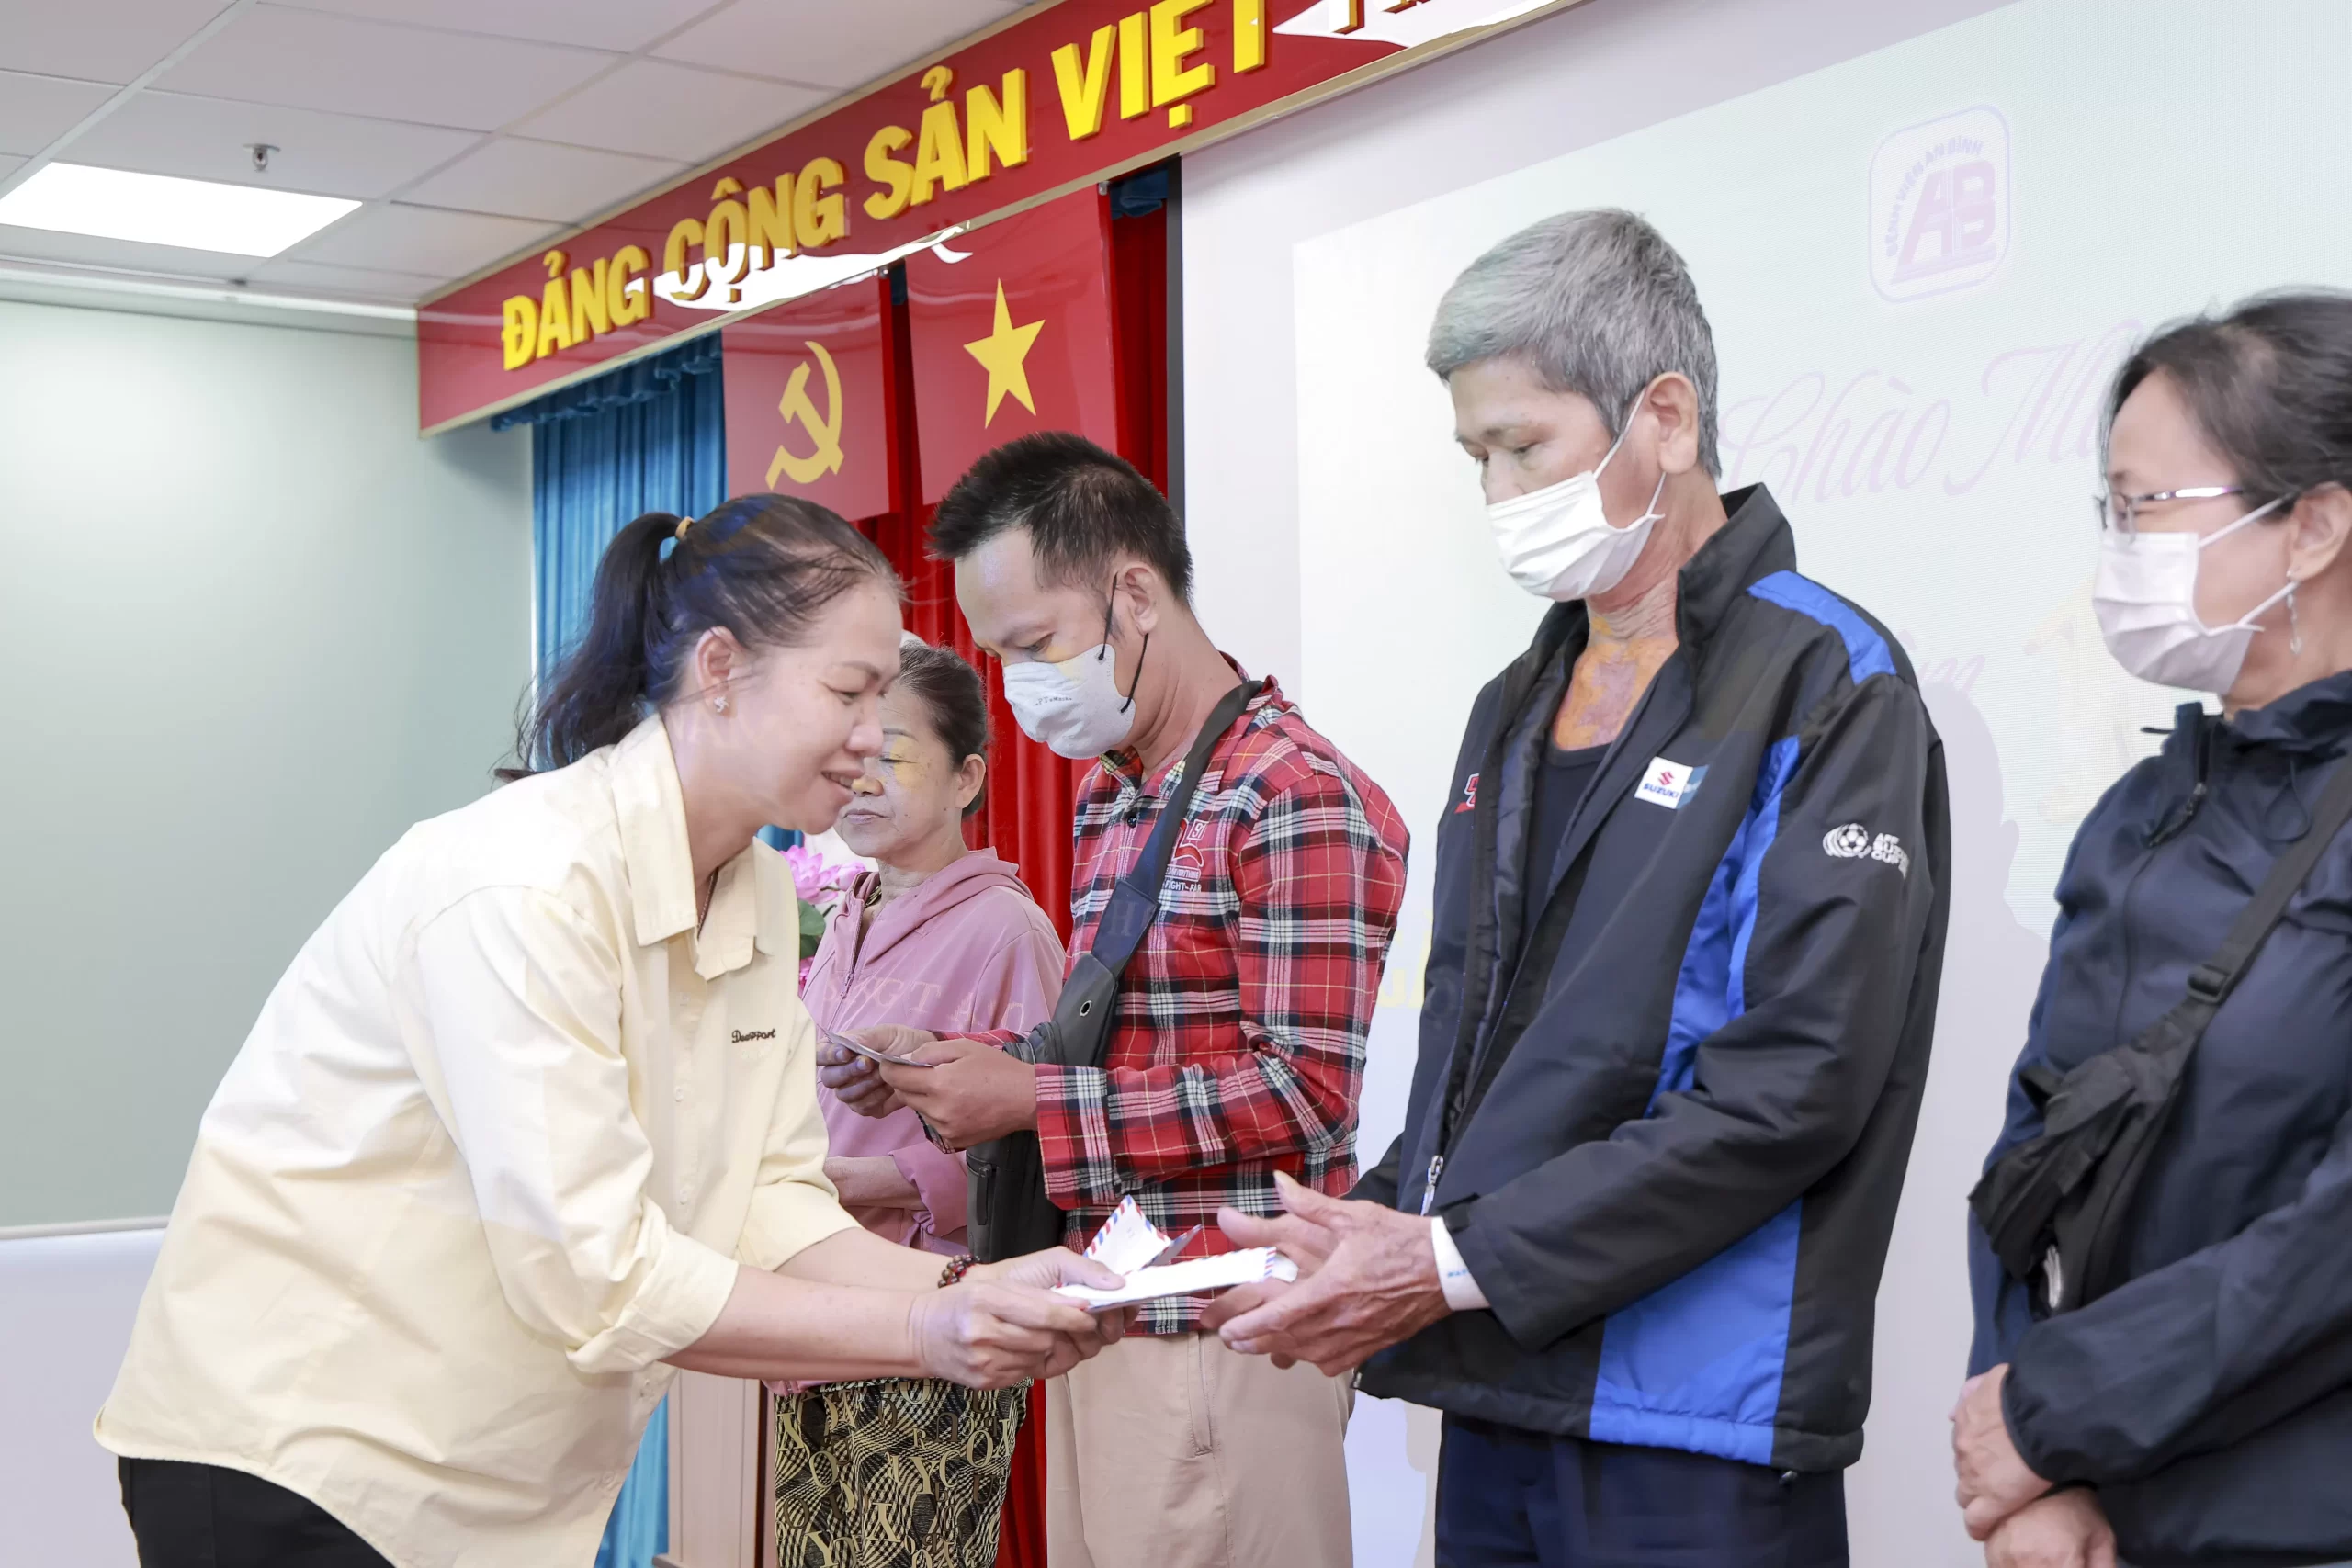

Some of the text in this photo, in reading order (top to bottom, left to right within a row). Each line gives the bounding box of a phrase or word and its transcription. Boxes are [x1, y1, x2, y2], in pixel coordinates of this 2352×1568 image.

[501, 243, 653, 371] ĐẢNG
[663, 156, 850, 304] CỘNG
[864, 65, 1031, 220] SẢN
[1643, 782, 1680, 798] SUZUKI
